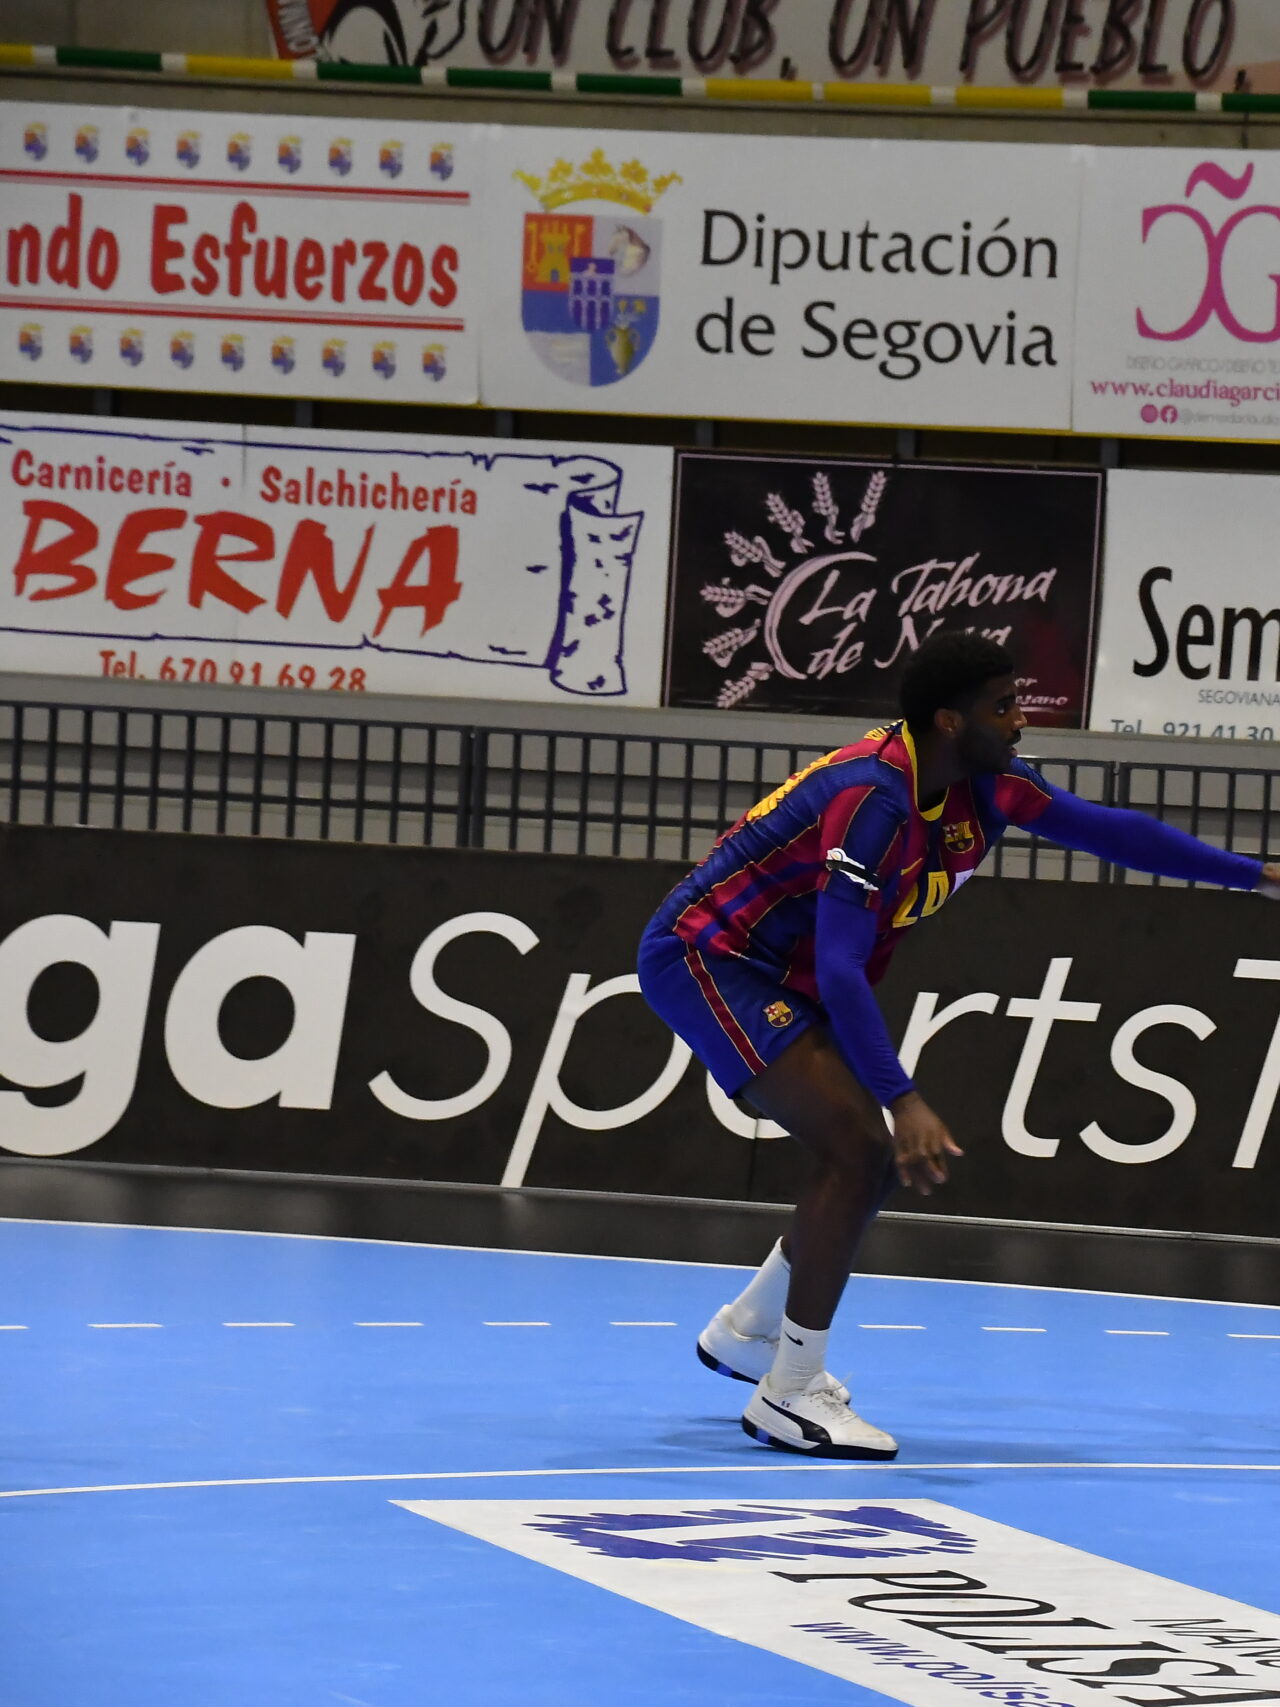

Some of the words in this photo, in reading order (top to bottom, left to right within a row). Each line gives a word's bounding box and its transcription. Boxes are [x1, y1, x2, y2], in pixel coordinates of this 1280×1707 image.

[151, 201, 459, 308] Esfuerzos
[700, 208, 1058, 285] Diputación
[696, 297, 776, 355] de
[802, 301, 1058, 380] Segovia
[11, 448, 192, 497] Carnicería
[260, 465, 478, 516] Salchichería
[13, 500, 463, 638] BERNA
[799, 569, 877, 625] La
[891, 552, 1057, 617] Tahona
[100, 650, 146, 680] Tel.
[160, 656, 218, 684] 670
[229, 661, 262, 687] 91
[278, 663, 316, 689] 69
[330, 666, 366, 691] 28
[807, 622, 865, 680] de
